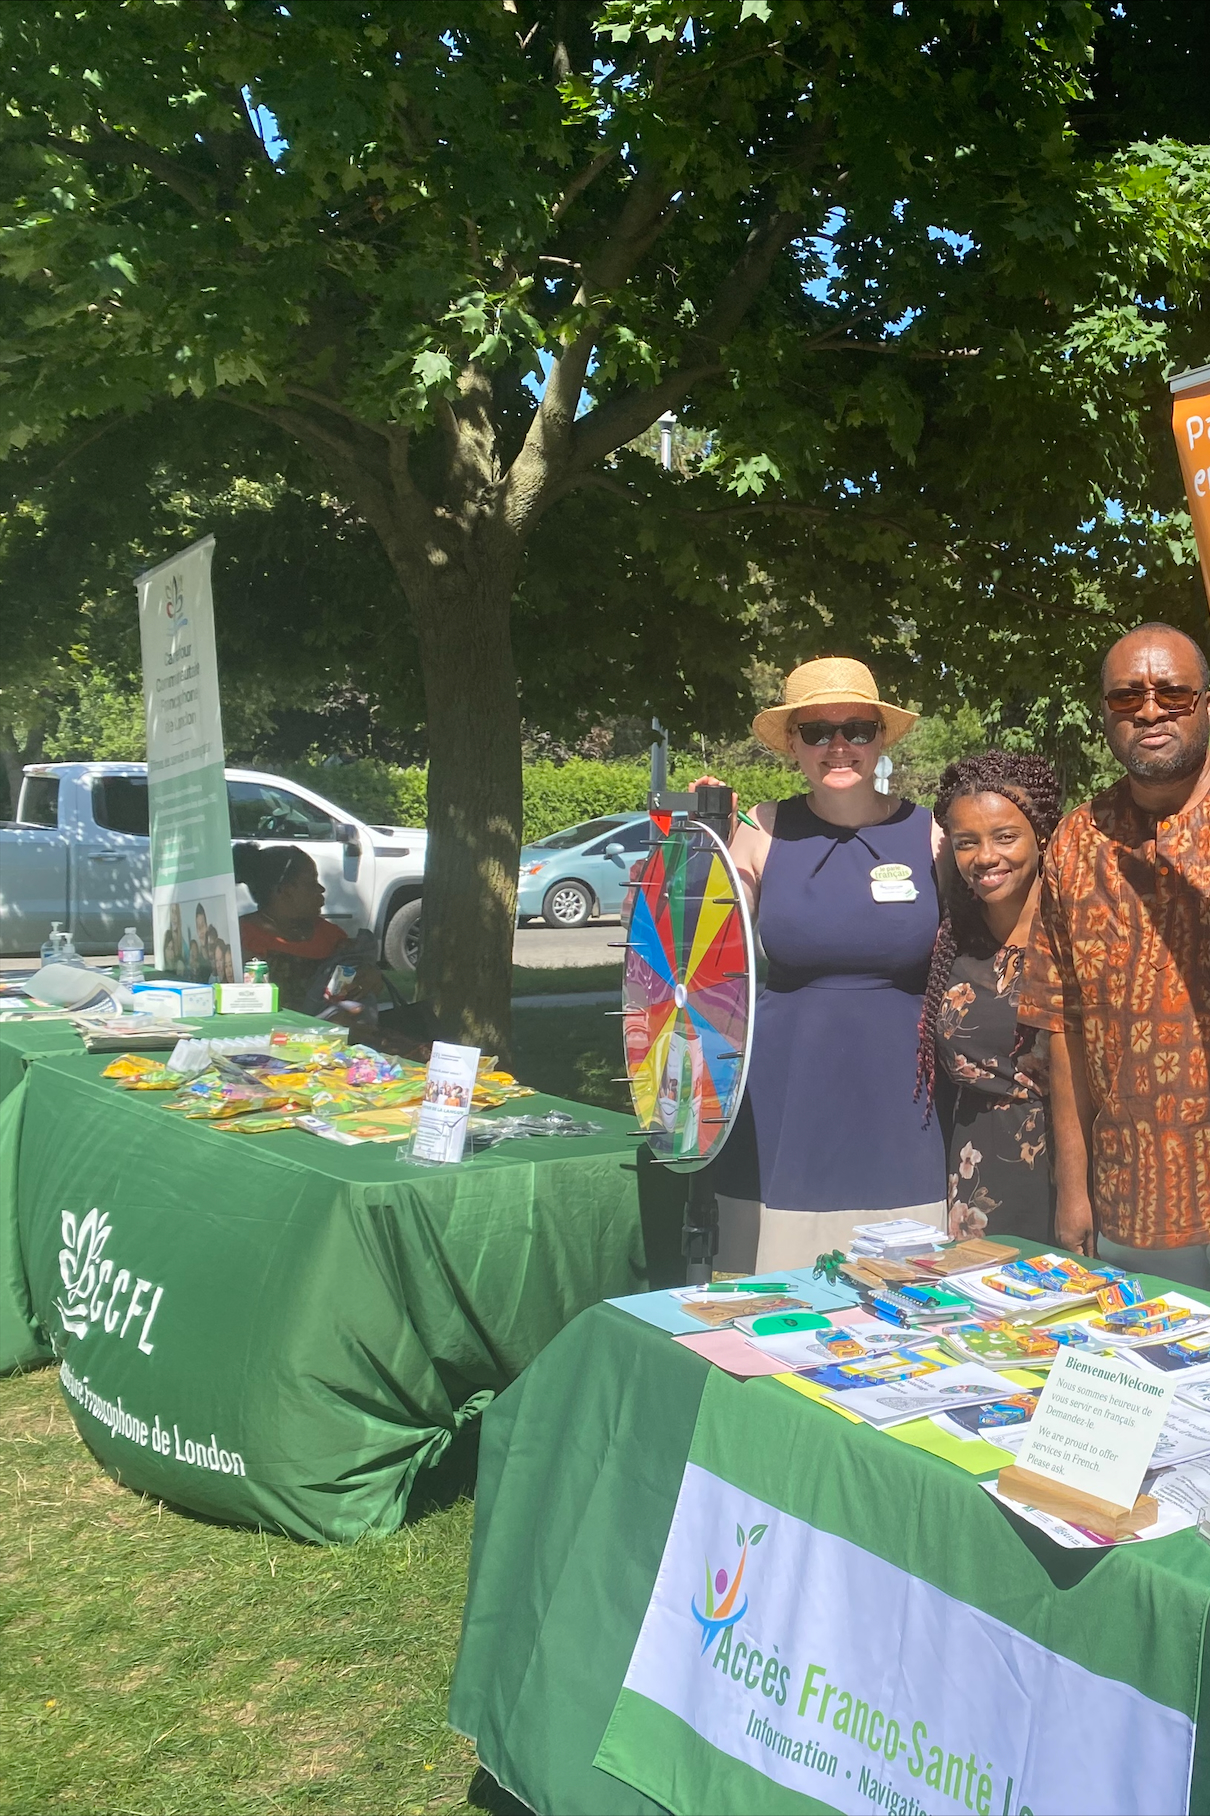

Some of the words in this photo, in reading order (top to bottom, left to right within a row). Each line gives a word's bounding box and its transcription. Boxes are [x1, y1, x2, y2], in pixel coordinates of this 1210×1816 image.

[875, 869, 909, 879] français
[91, 1259, 164, 1355] CCFL
[1065, 1356, 1165, 1398] Bienvenue/Welcome
[1051, 1393, 1068, 1407] vous
[1070, 1398, 1092, 1413] servir
[1093, 1406, 1103, 1416] en
[1104, 1408, 1136, 1428] français.
[1056, 1377, 1076, 1394] Nous
[1077, 1385, 1108, 1402] sommes
[1109, 1395, 1141, 1413] heureux
[1142, 1404, 1153, 1417] de
[83, 1376, 148, 1447] Francophone
[152, 1415, 170, 1456] de
[174, 1424, 246, 1477] London
[1046, 1404, 1095, 1430] Demandez-le.
[1032, 1440, 1061, 1459] services
[1063, 1449, 1071, 1461] in
[1072, 1454, 1100, 1472] French.
[1038, 1425, 1051, 1438] We
[1051, 1431, 1064, 1442] are
[1064, 1435, 1088, 1452] proud
[1090, 1443, 1098, 1455] to
[1099, 1446, 1119, 1462] offer
[1026, 1453, 1050, 1470] Please
[1051, 1462, 1065, 1476] ask.
[712, 1623, 791, 1707] Accès
[797, 1663, 994, 1816] Franco-Santé
[745, 1709, 838, 1778] Information
[857, 1765, 934, 1816] Navigati
